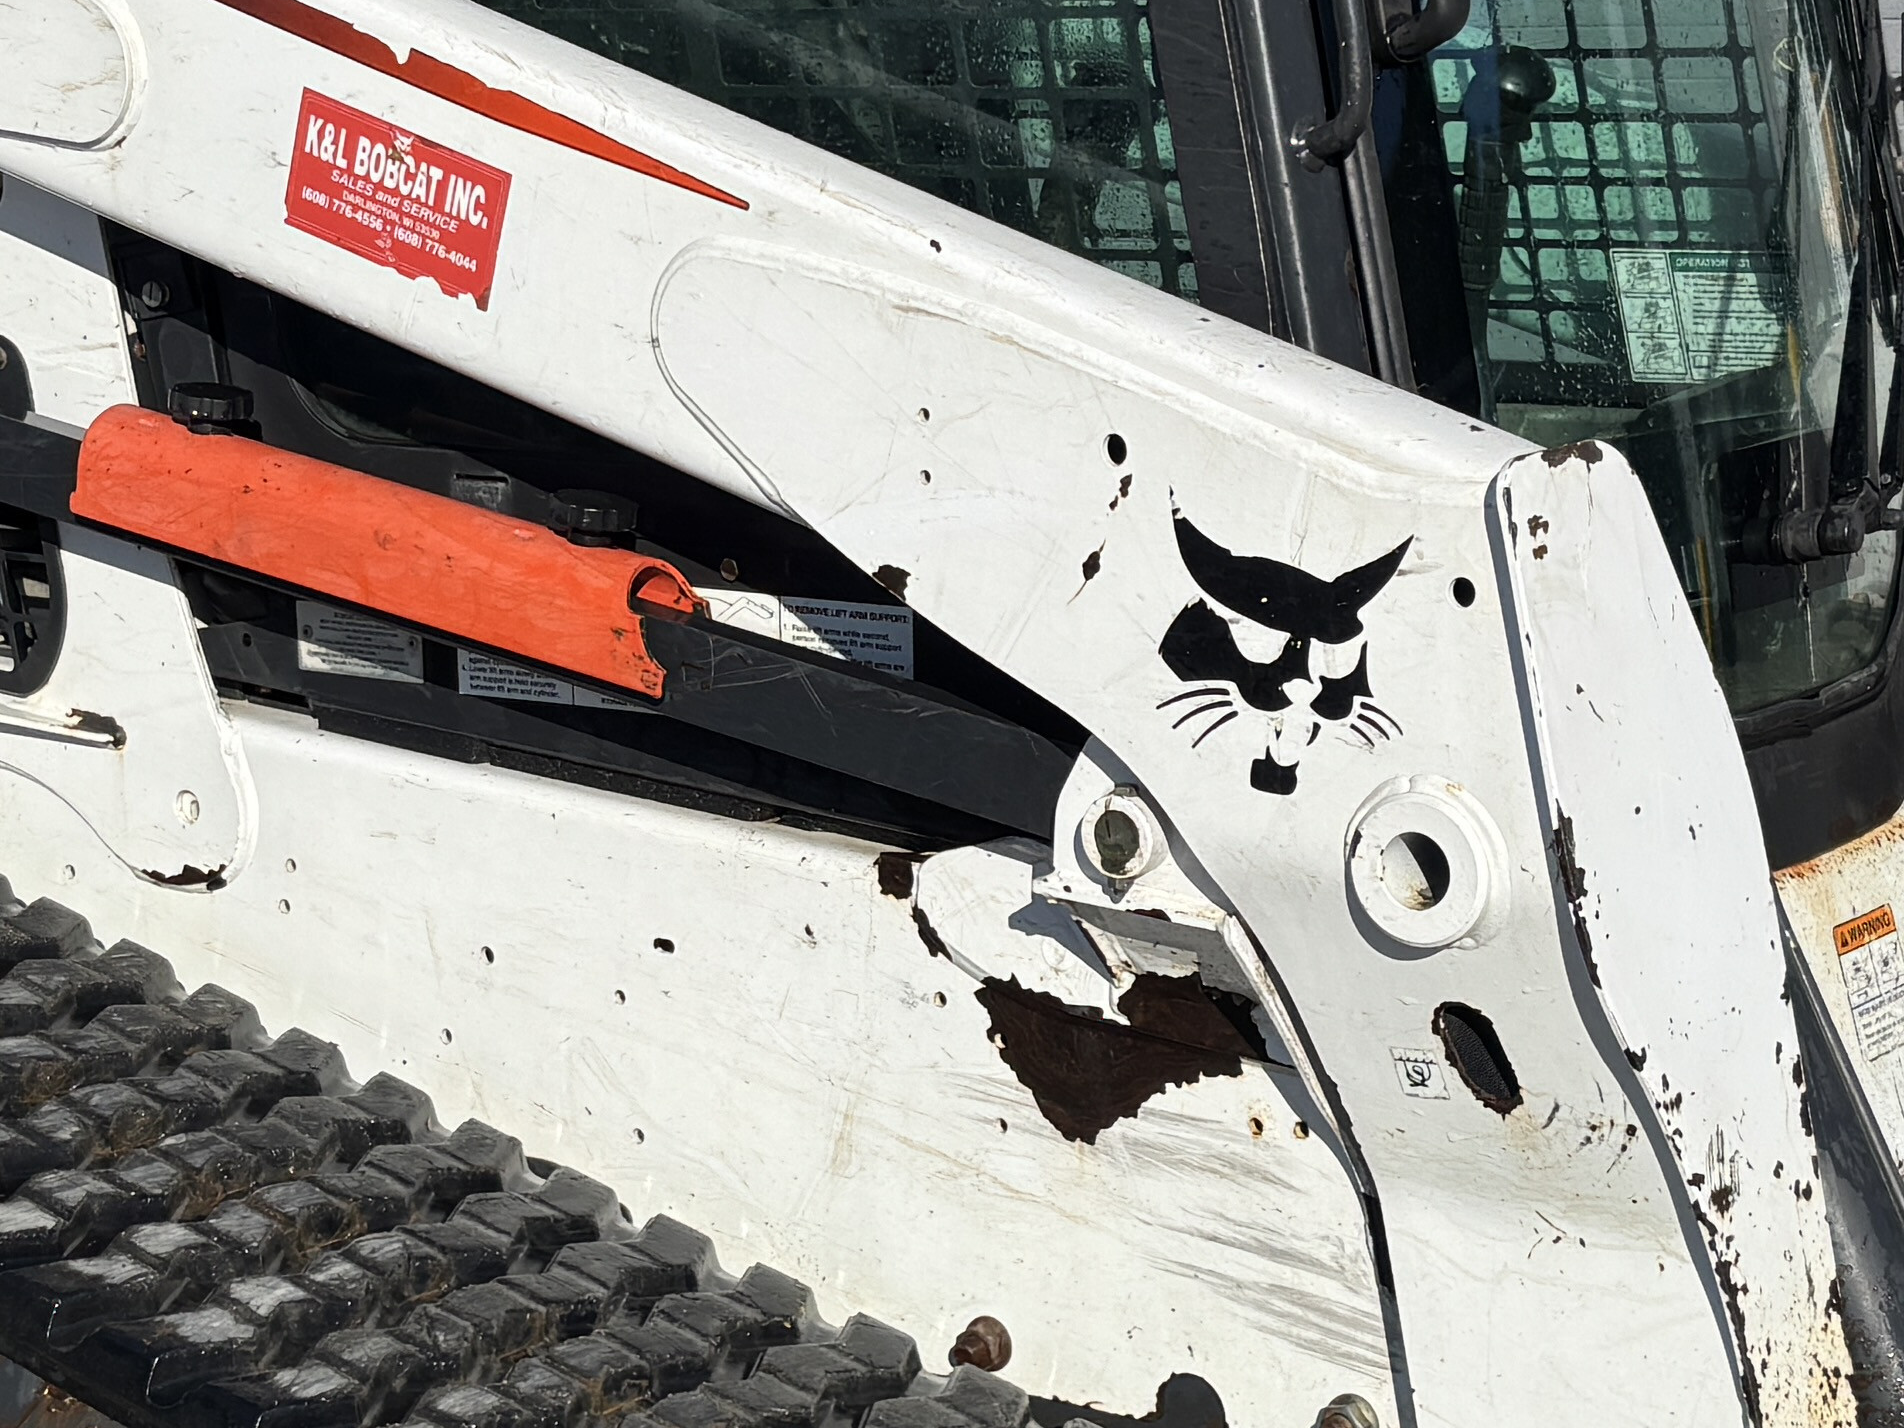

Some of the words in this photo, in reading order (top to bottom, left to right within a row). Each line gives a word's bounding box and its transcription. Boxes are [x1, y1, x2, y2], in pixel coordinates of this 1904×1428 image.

[304, 114, 348, 170] K&L
[353, 135, 444, 207] BOBCAT
[444, 173, 488, 230] INC.
[330, 169, 375, 197] SALES
[375, 190, 401, 208] and
[401, 199, 460, 234] SERVICE
[301, 185, 330, 210] (608)
[331, 198, 385, 232] 776-4556
[393, 224, 423, 250] (608)
[424, 238, 477, 273] 776-4044
